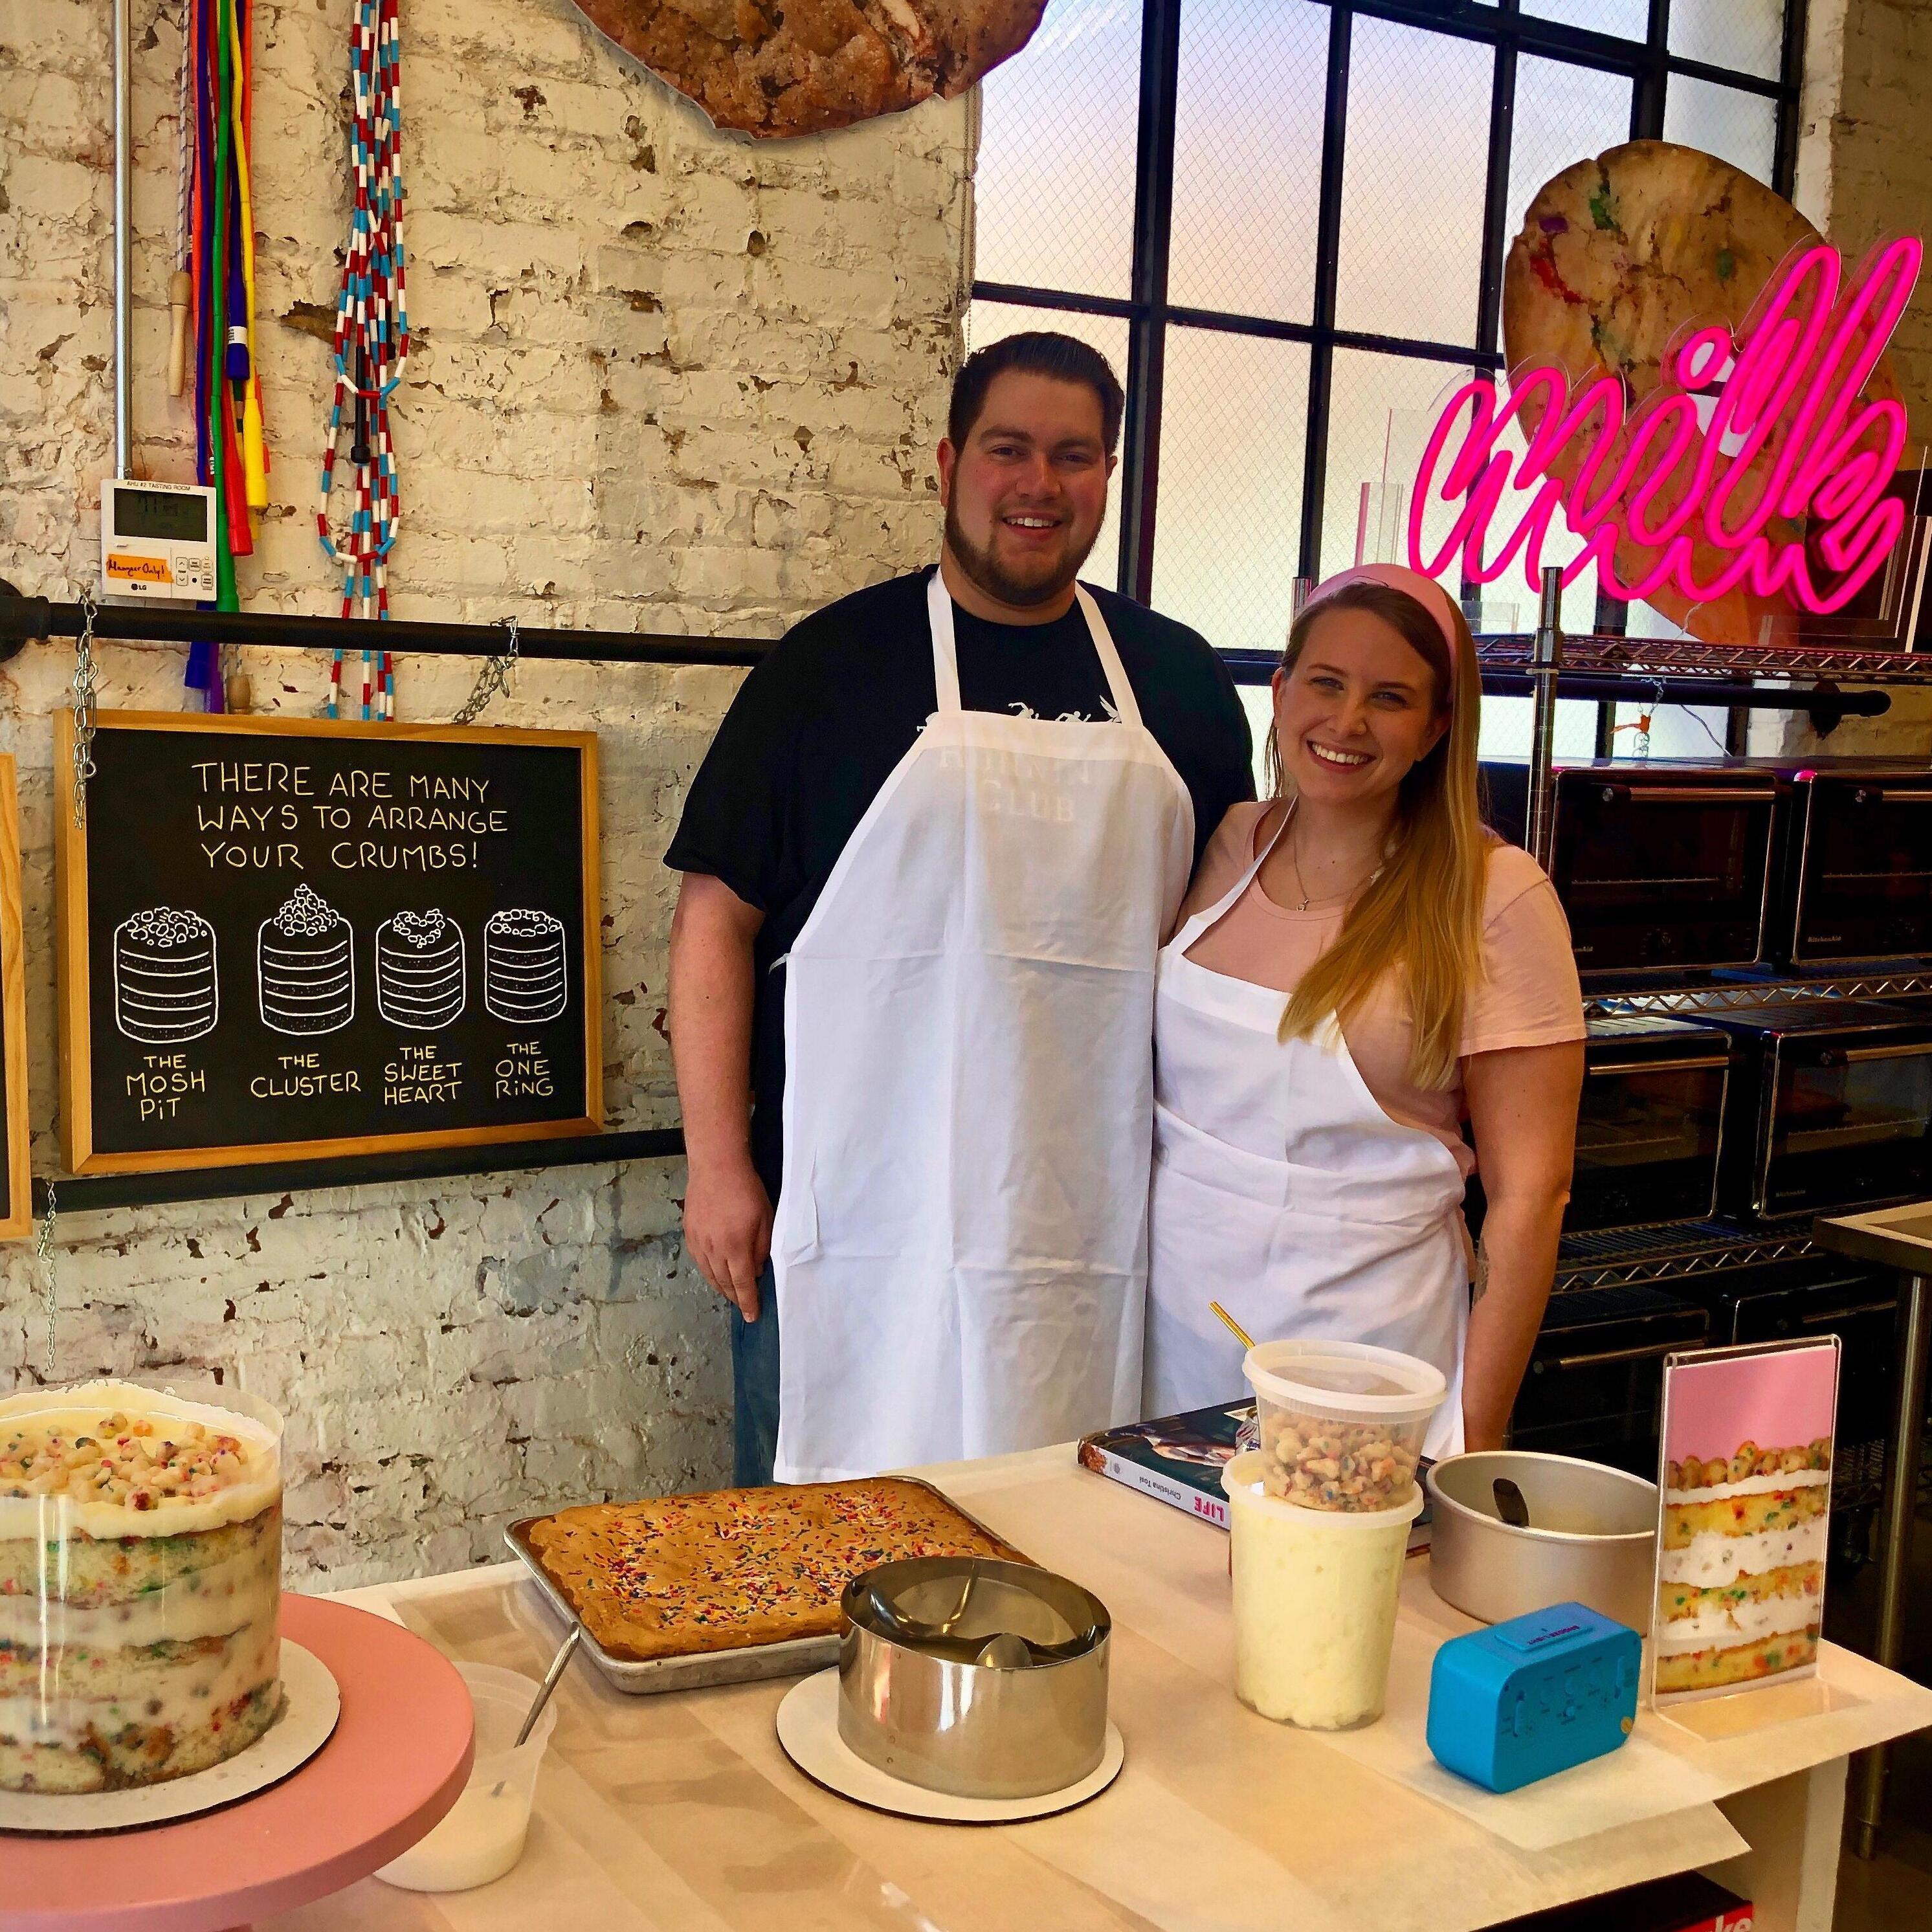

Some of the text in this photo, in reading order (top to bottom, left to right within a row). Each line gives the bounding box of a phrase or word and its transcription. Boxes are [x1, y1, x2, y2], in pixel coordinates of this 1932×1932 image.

[191, 761, 490, 804] THERE ARE MANY
[197, 804, 509, 834] WAYS TO ARRANGE
[201, 841, 478, 872] YOUR CRUMBS!
[143, 1053, 187, 1069] THE
[278, 1052, 320, 1070] THE
[399, 1045, 438, 1061] THE
[506, 1041, 542, 1056] THE
[384, 1061, 463, 1083] SWEET
[494, 1059, 551, 1078] ONE
[126, 1069, 206, 1096] MOSH
[250, 1070, 362, 1098] CLUSTER
[384, 1080, 463, 1106] HEART
[1139, 1476, 1181, 1500] Christina Tosi
[1194, 1495, 1225, 1522] LIFE
